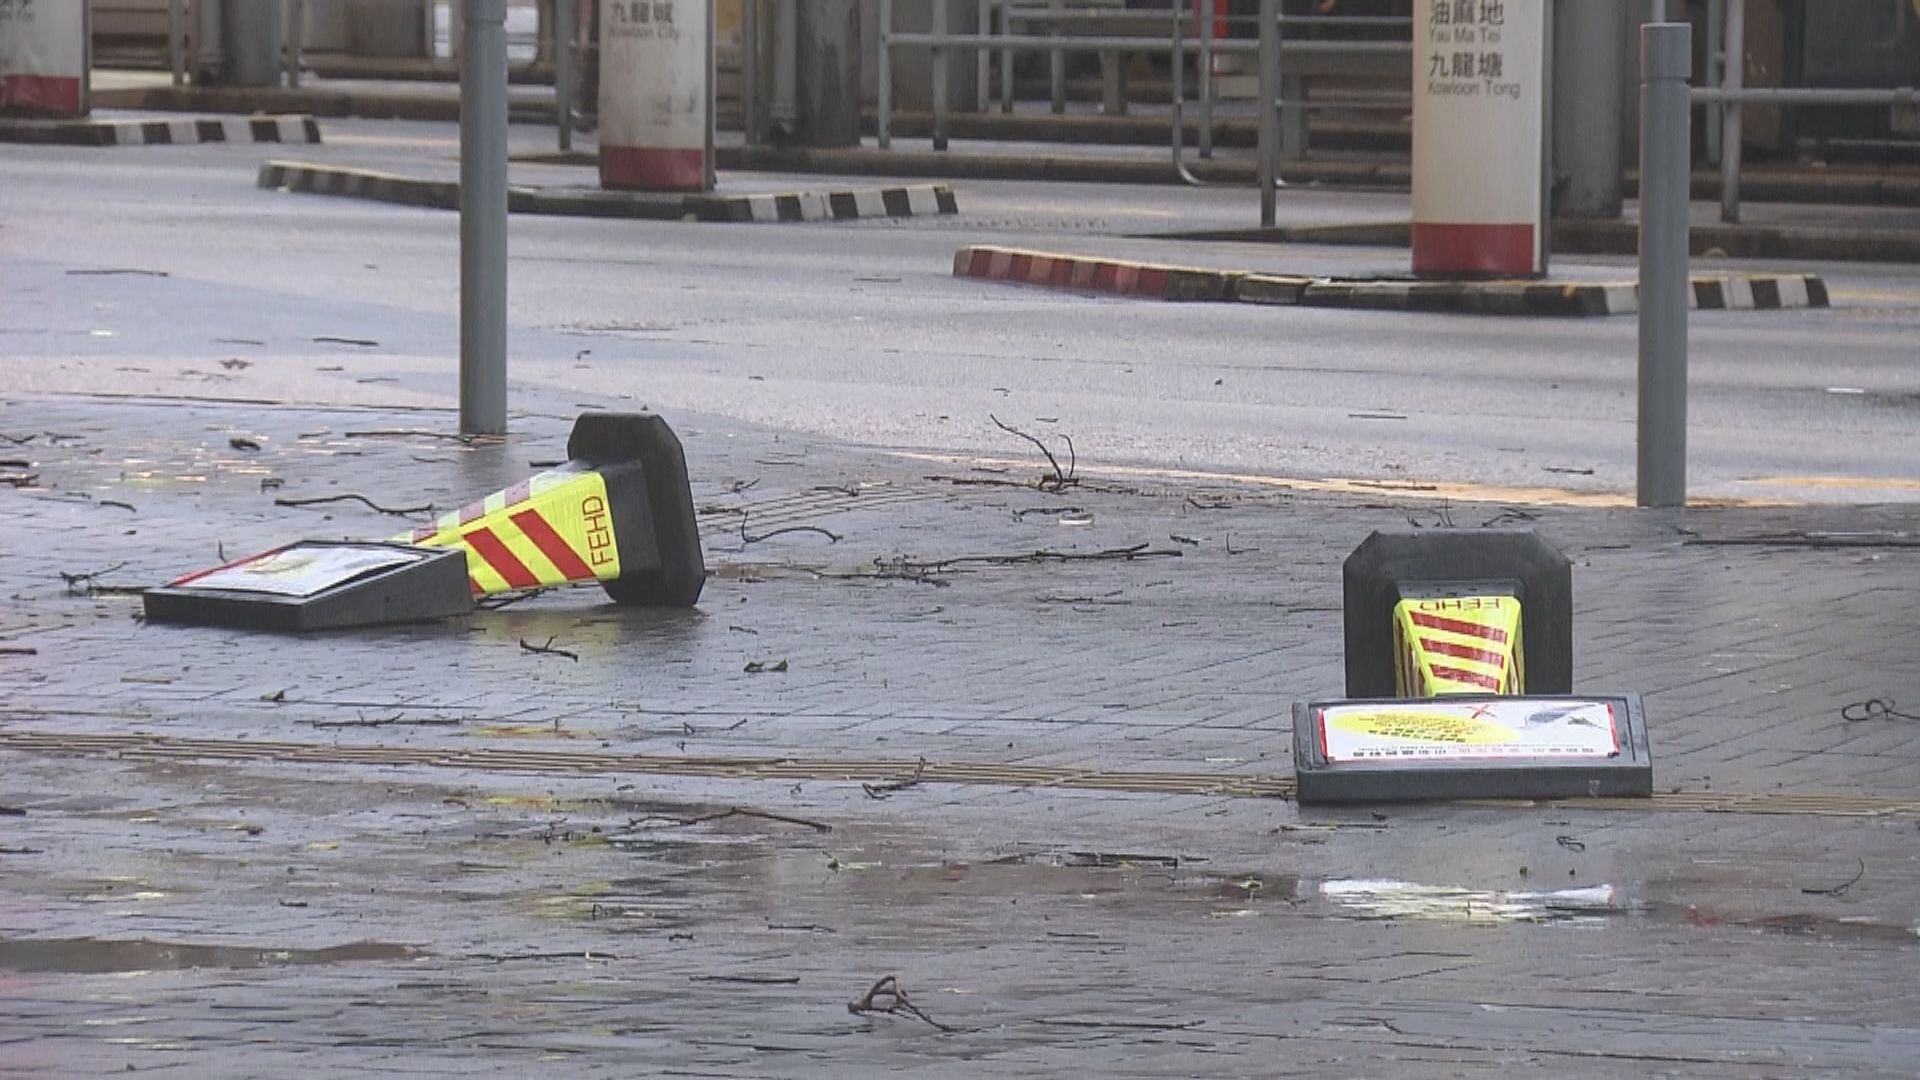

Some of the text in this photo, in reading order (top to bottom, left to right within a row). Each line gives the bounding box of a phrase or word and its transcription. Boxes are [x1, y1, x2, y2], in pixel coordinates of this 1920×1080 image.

[1430, 0, 1504, 25] 油麻地
[1430, 26, 1501, 42] Yau Ma Tei
[1429, 51, 1503, 77] 九龍塘
[1427, 80, 1520, 100] Kowloon Tong
[582, 496, 614, 565] FEHD
